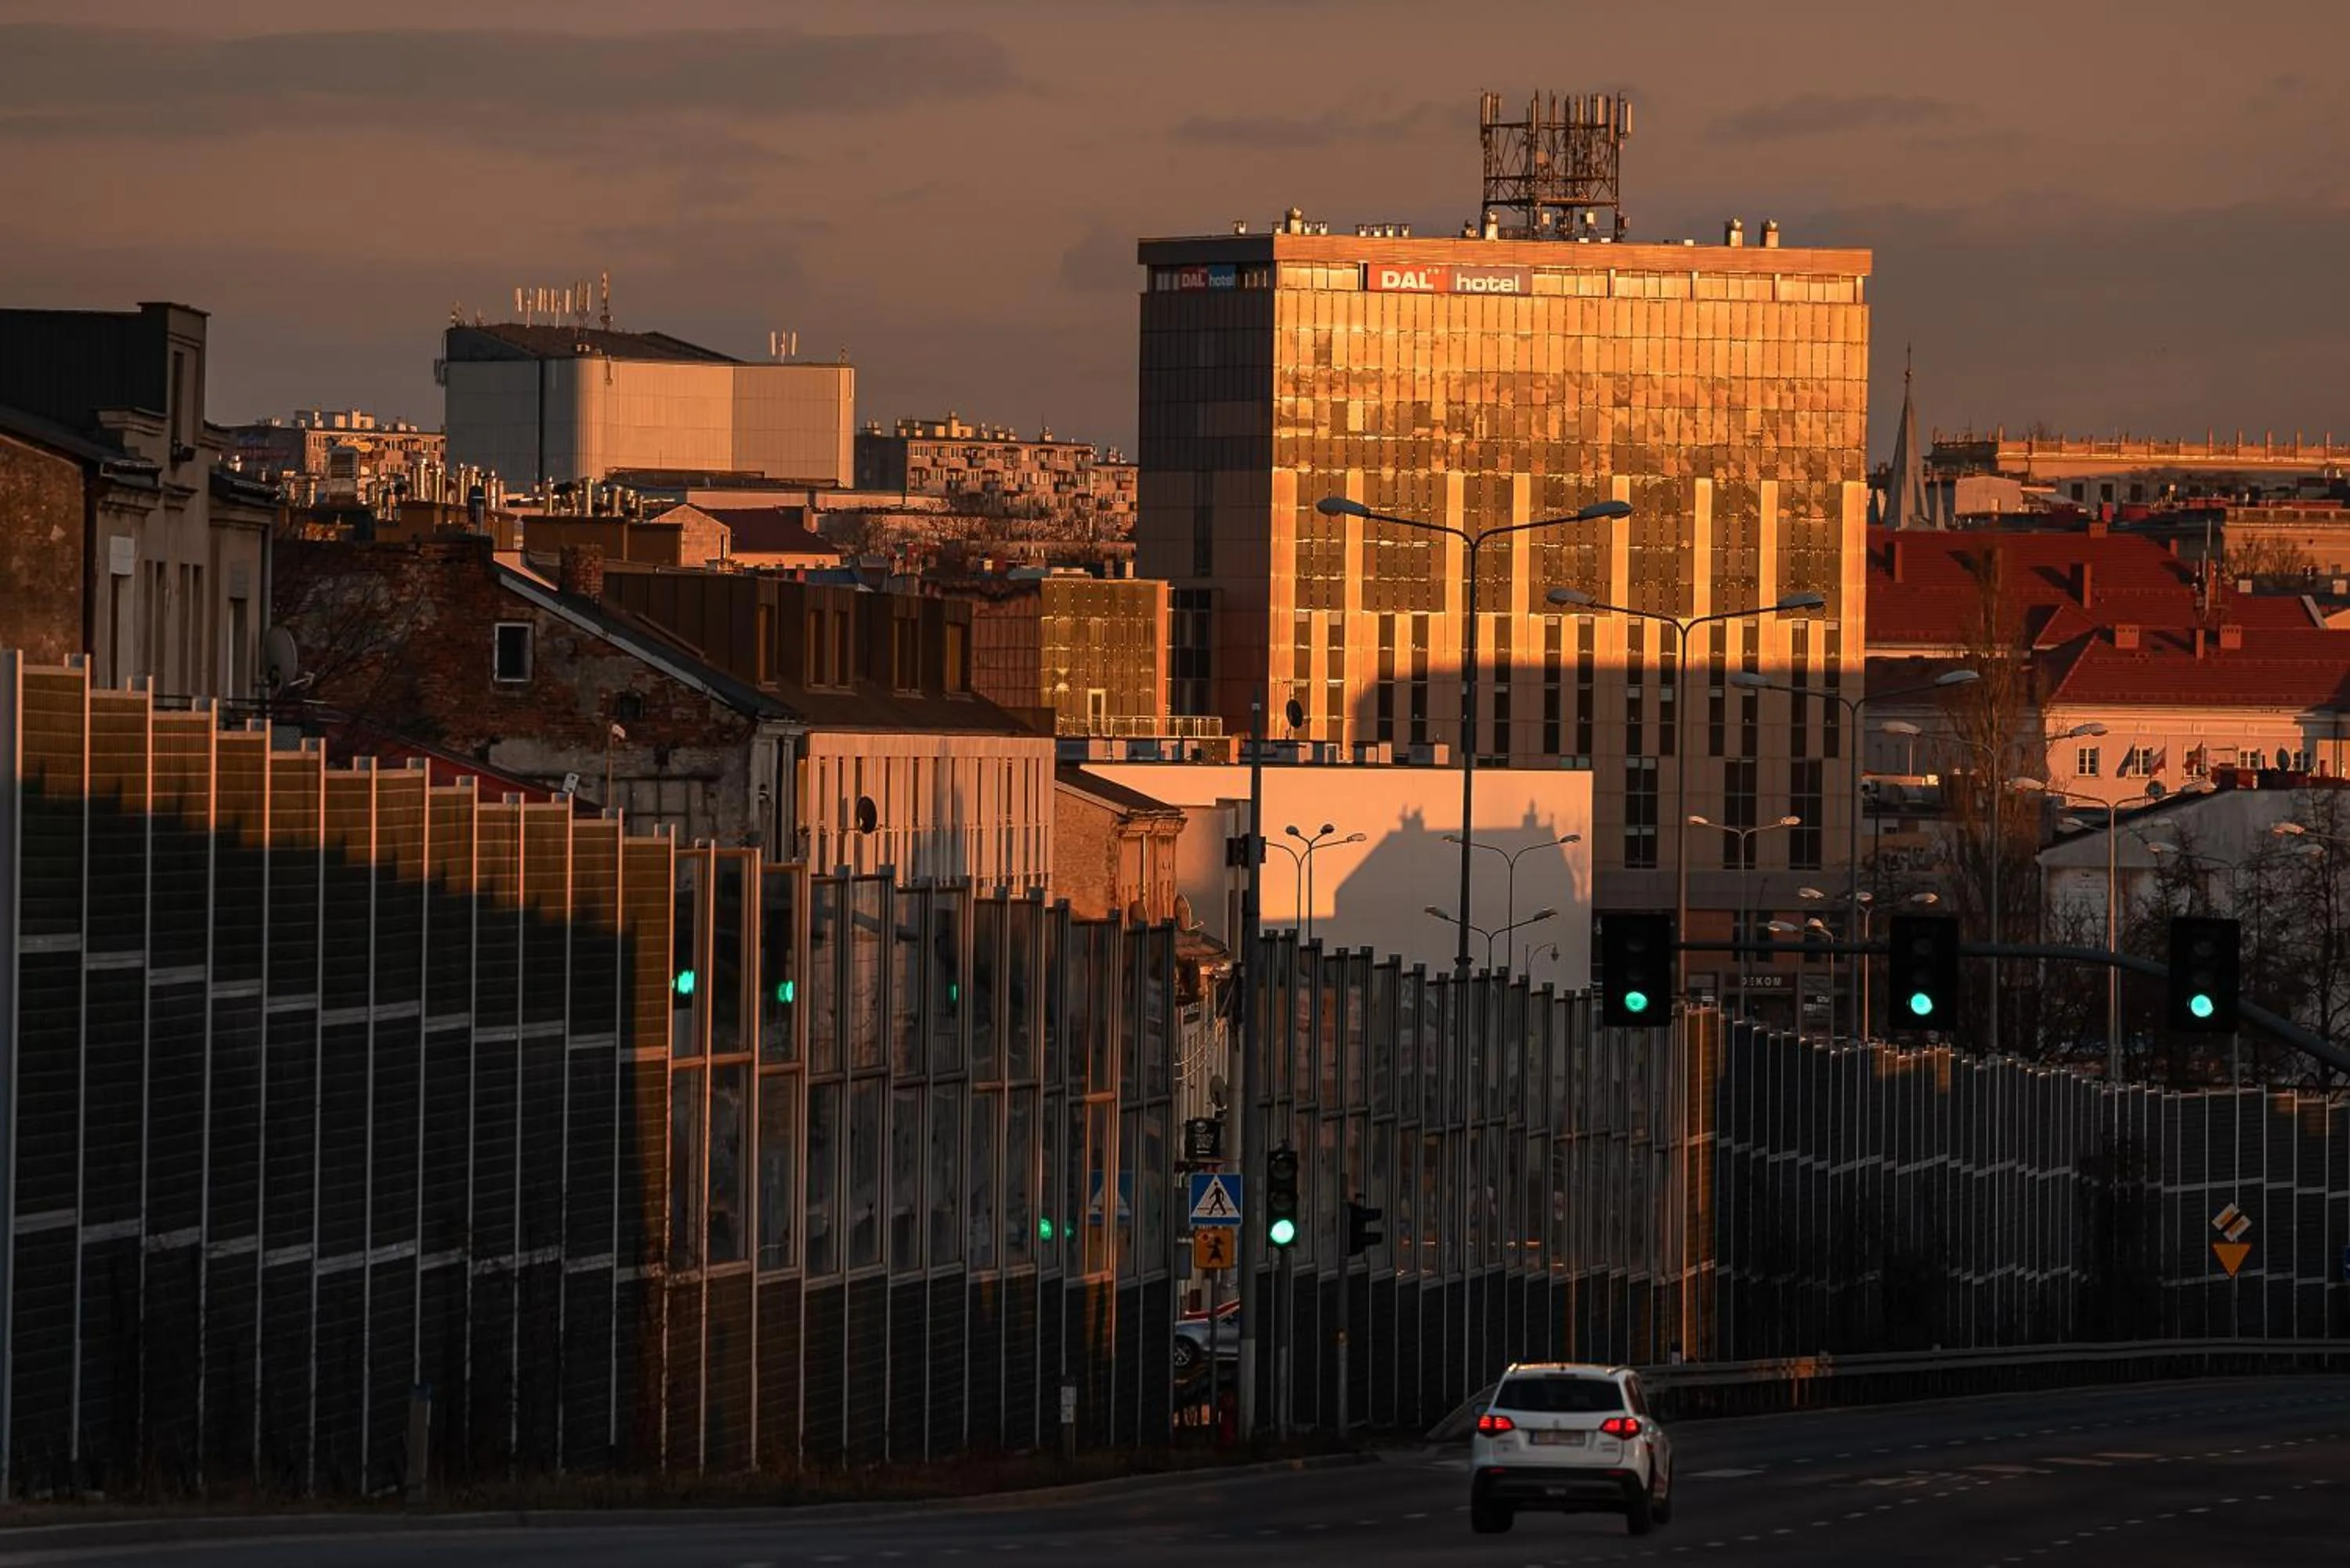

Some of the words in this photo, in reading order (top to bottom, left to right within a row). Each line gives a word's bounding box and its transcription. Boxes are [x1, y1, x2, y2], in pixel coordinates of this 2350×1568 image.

[1181, 273, 1206, 289] DAL
[1209, 271, 1236, 289] hotel
[1381, 270, 1434, 289] DAL
[1456, 273, 1520, 292] hotel
